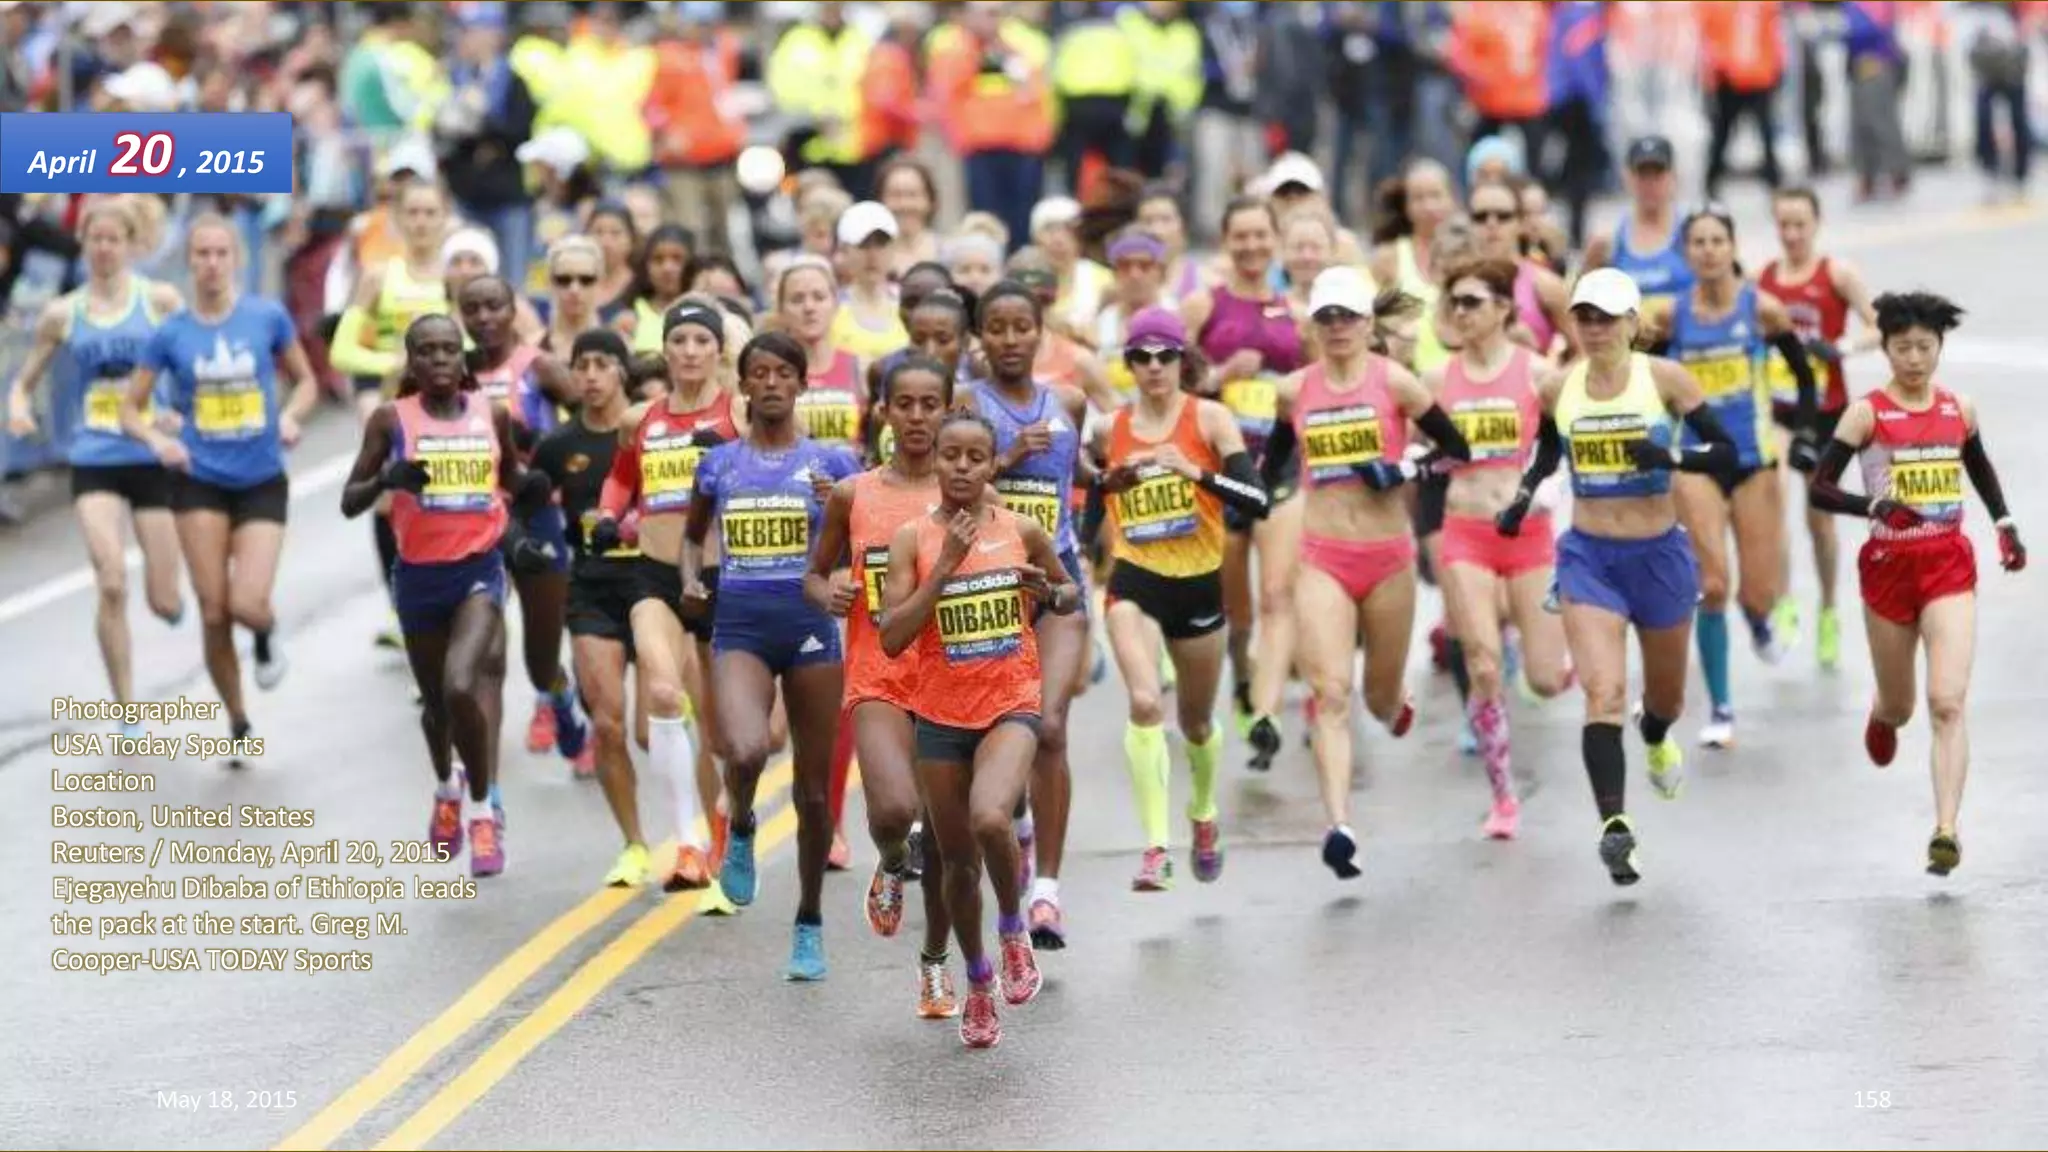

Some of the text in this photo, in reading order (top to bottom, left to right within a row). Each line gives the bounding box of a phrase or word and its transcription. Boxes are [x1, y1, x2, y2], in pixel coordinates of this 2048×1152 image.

[1306, 428, 1378, 457] NELSON
[1118, 477, 1194, 519] NEMEC
[725, 516, 806, 548] KEBEDE
[938, 596, 1022, 635] DIBABA
